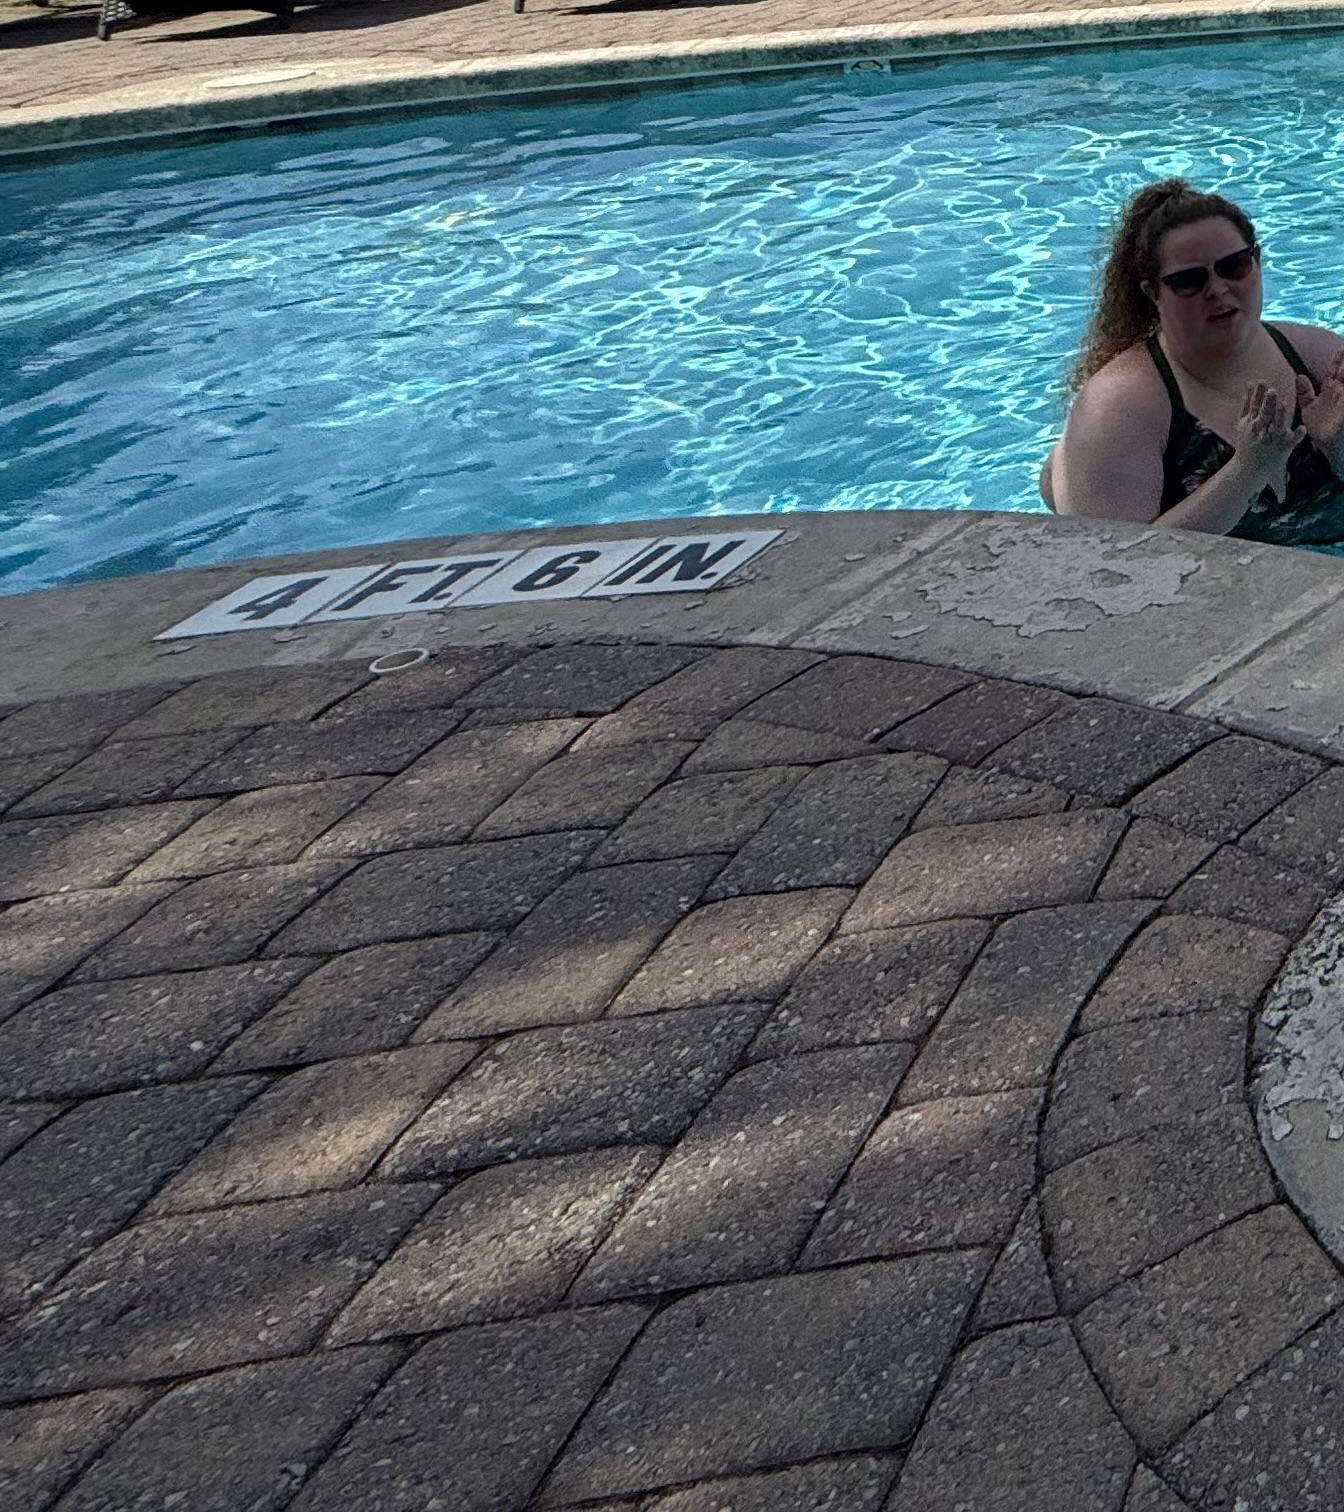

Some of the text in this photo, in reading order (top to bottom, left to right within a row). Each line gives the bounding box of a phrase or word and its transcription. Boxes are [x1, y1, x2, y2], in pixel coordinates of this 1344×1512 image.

[227, 540, 746, 621] 4 FT. 6 IN.
